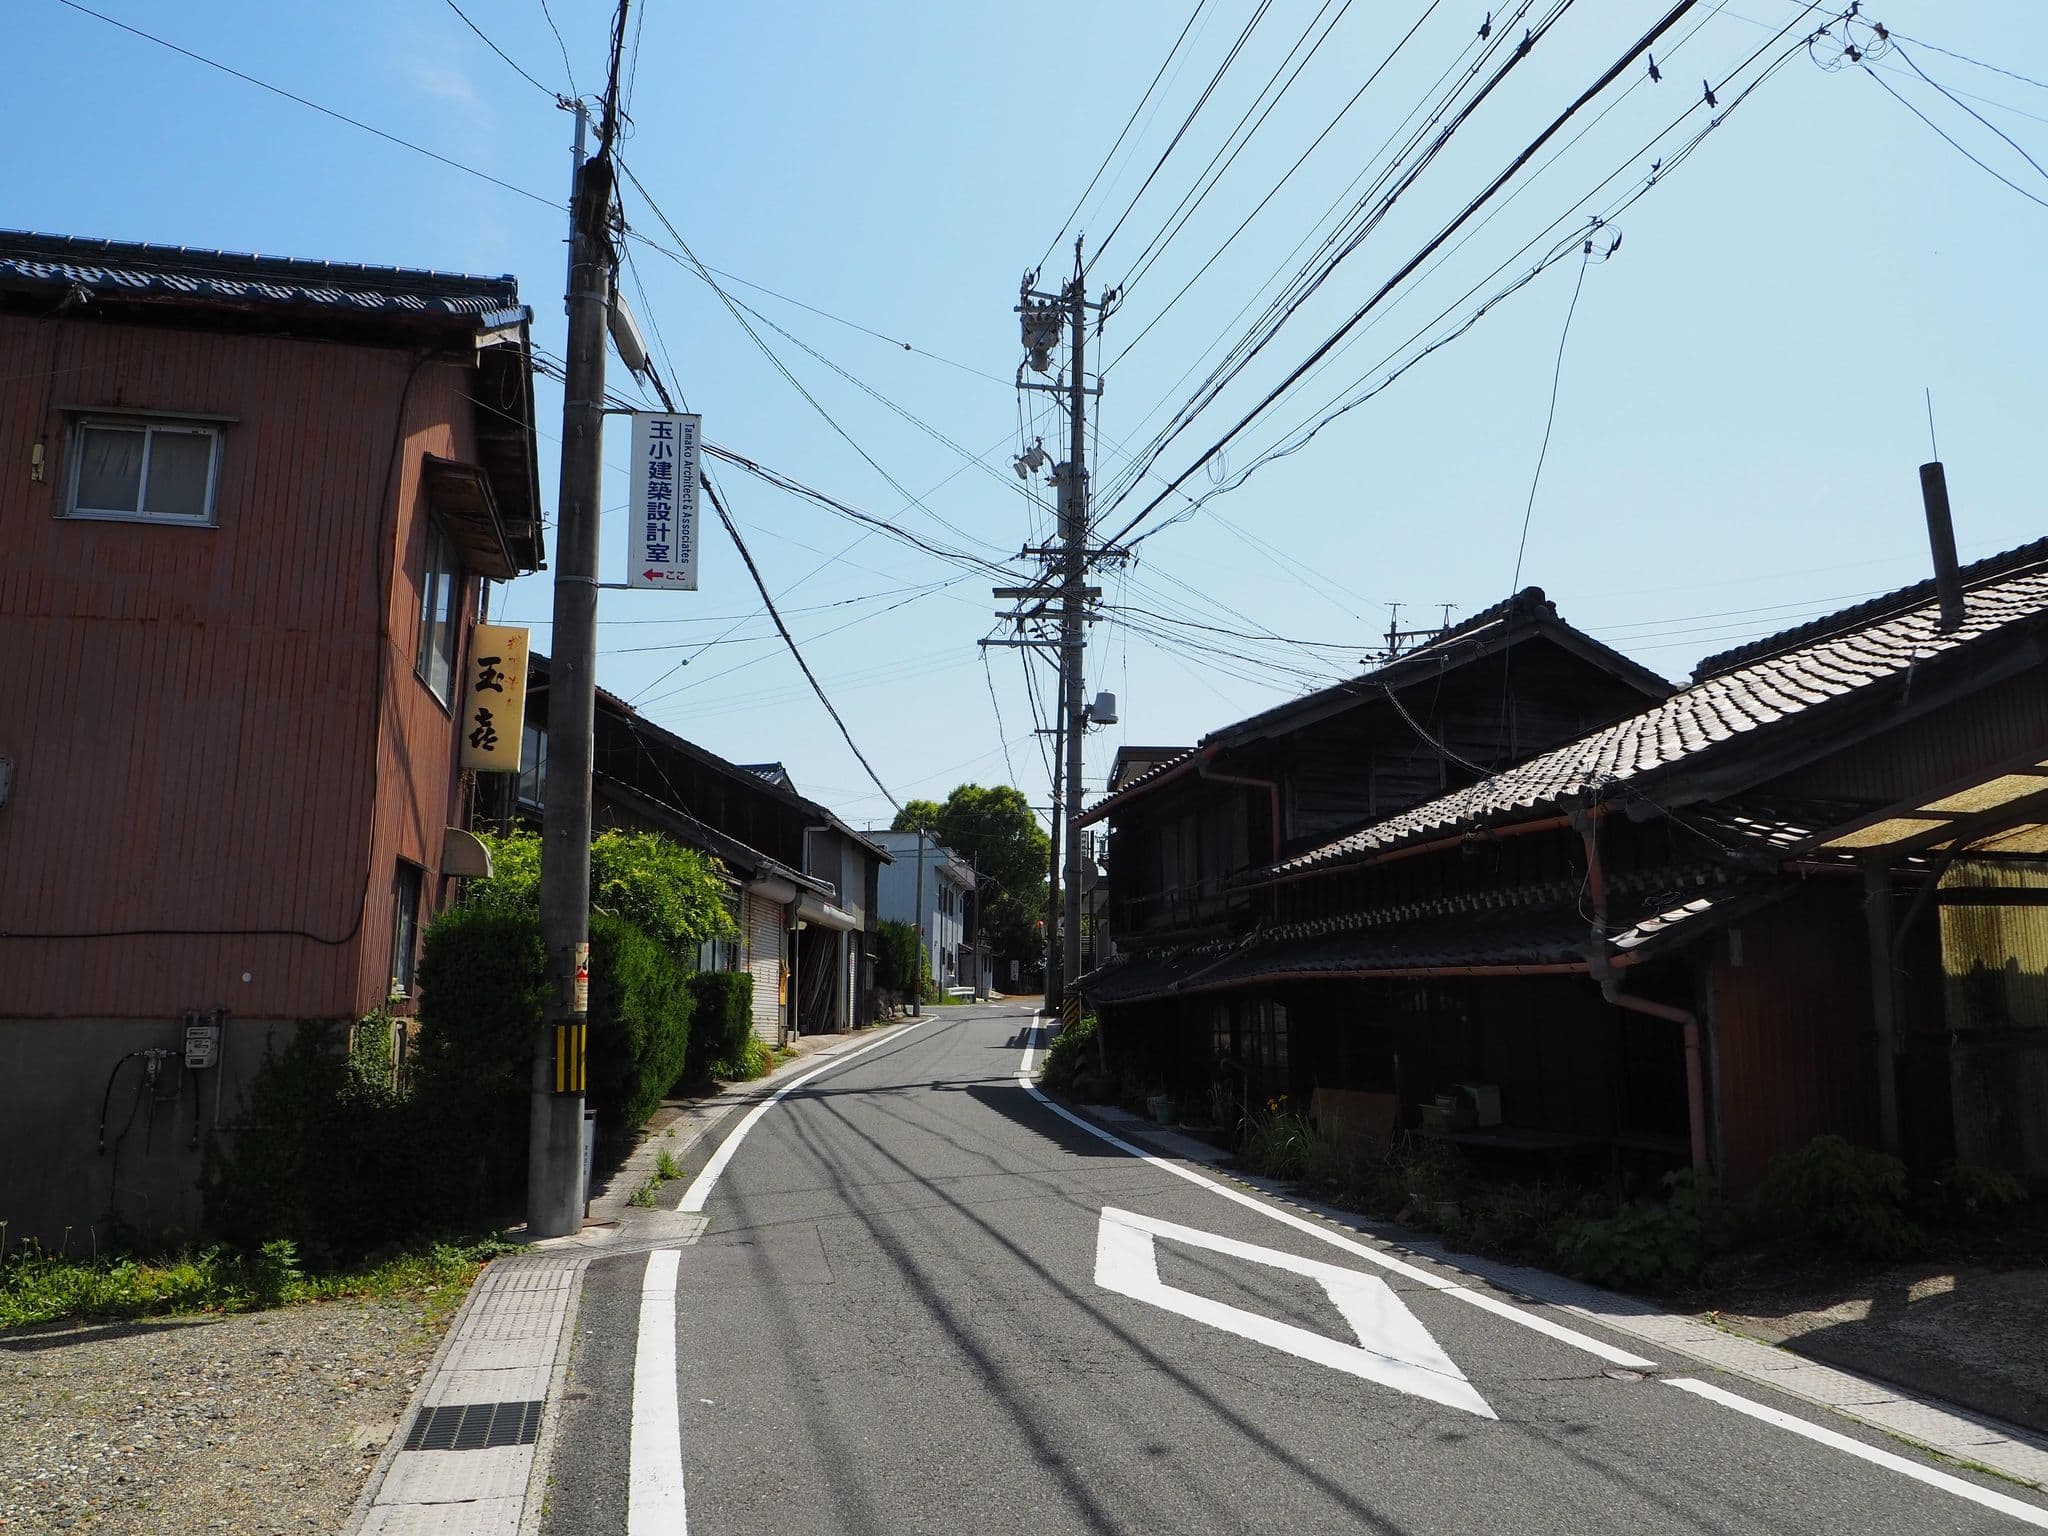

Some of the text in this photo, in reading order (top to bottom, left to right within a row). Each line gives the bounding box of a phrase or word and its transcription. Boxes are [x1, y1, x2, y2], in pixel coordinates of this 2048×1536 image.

[684, 423, 695, 458] Tamako
[645, 420, 673, 563] 玉小建築設計室
[682, 460, 694, 503] Architect
[681, 511, 692, 564] Associates
[666, 570, 686, 581] ここ
